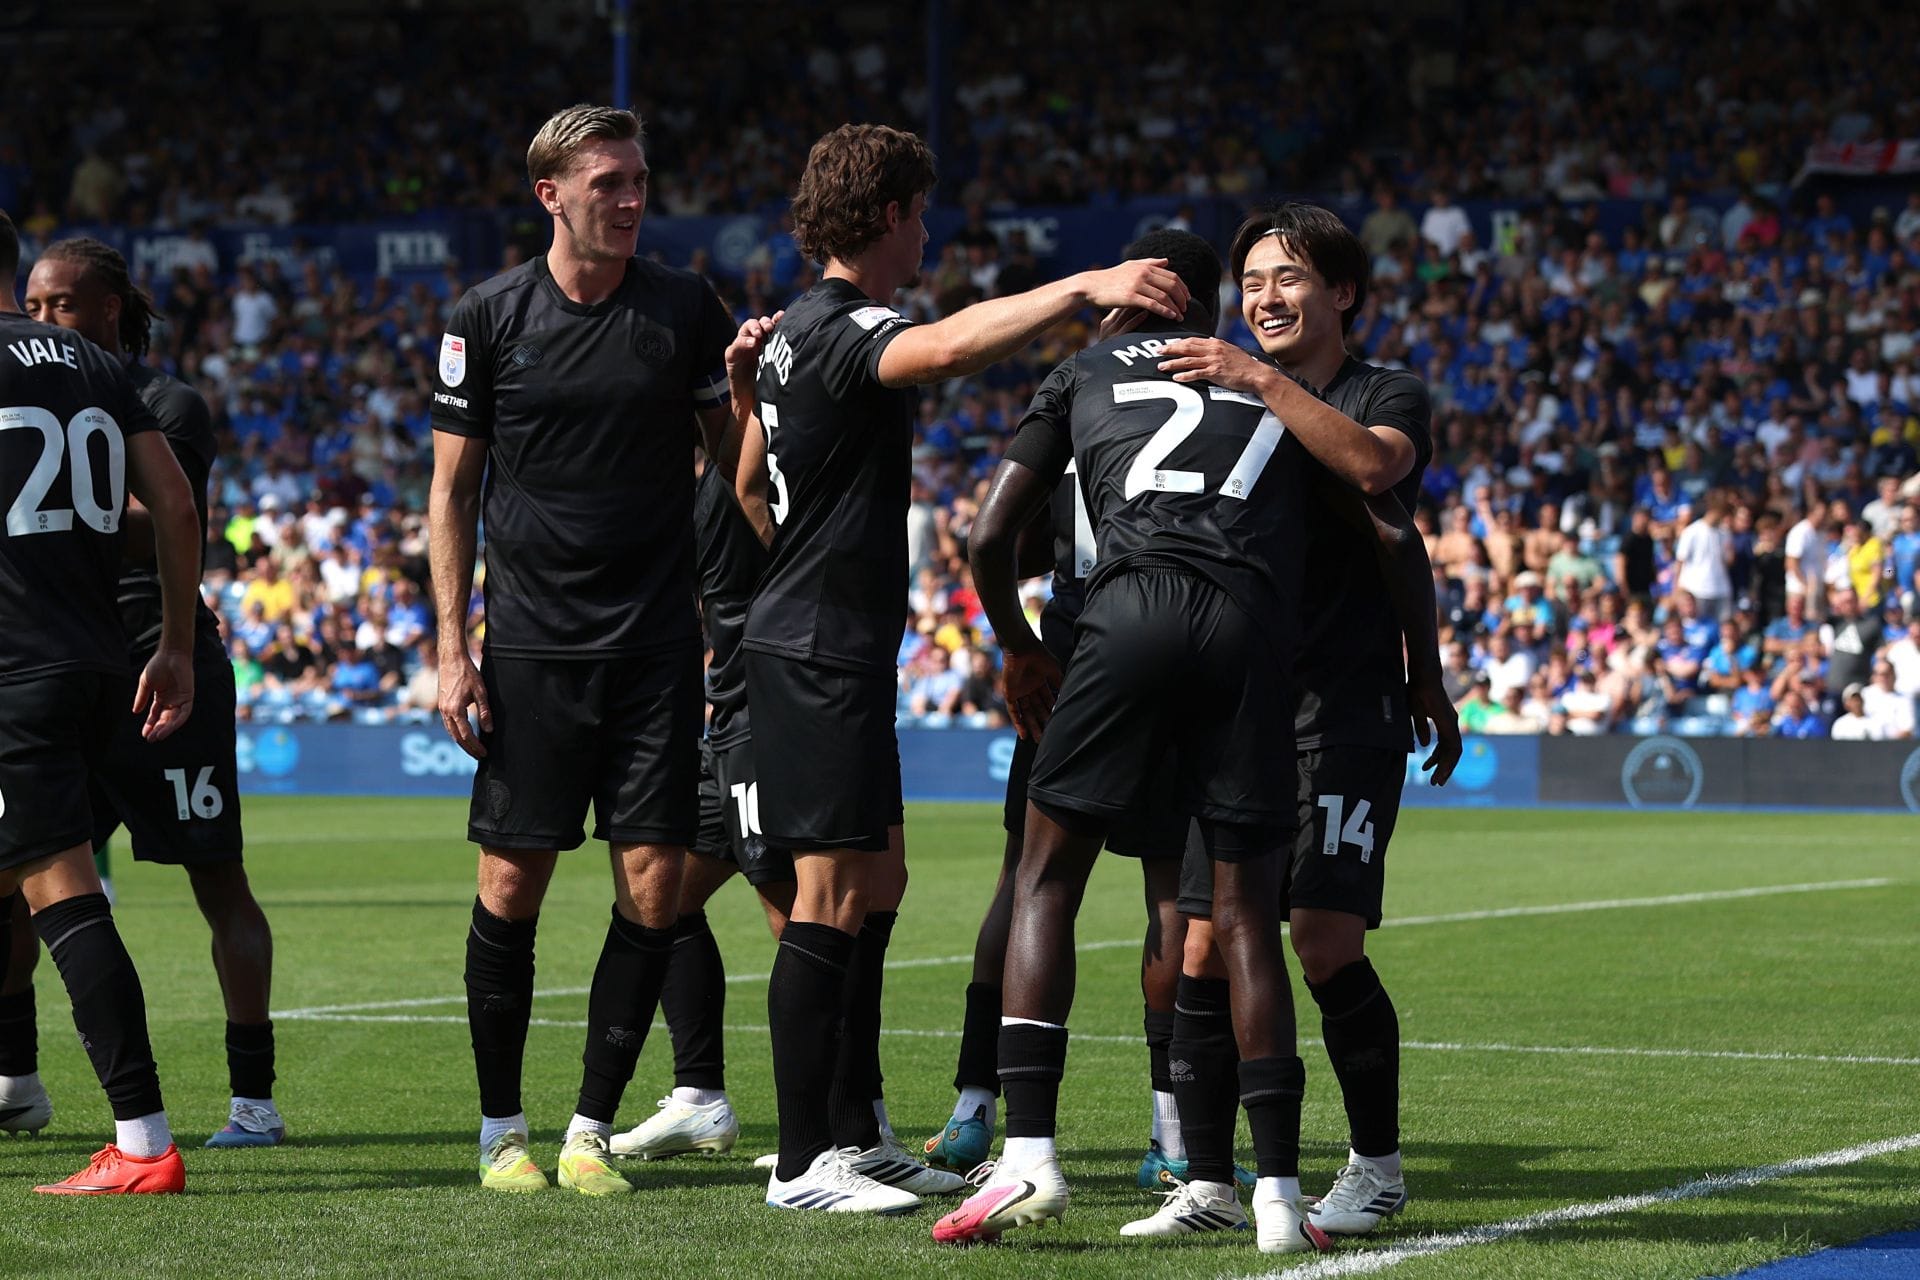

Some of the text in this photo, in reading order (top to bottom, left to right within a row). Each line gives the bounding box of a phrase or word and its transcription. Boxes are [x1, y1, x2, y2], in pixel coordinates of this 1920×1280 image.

[8, 338, 78, 370] VALE
[434, 392, 469, 409] TOGETHER
[0, 406, 126, 537] 20
[1113, 381, 1286, 501] 27
[164, 765, 223, 820] 16
[1317, 794, 1375, 864] 14
